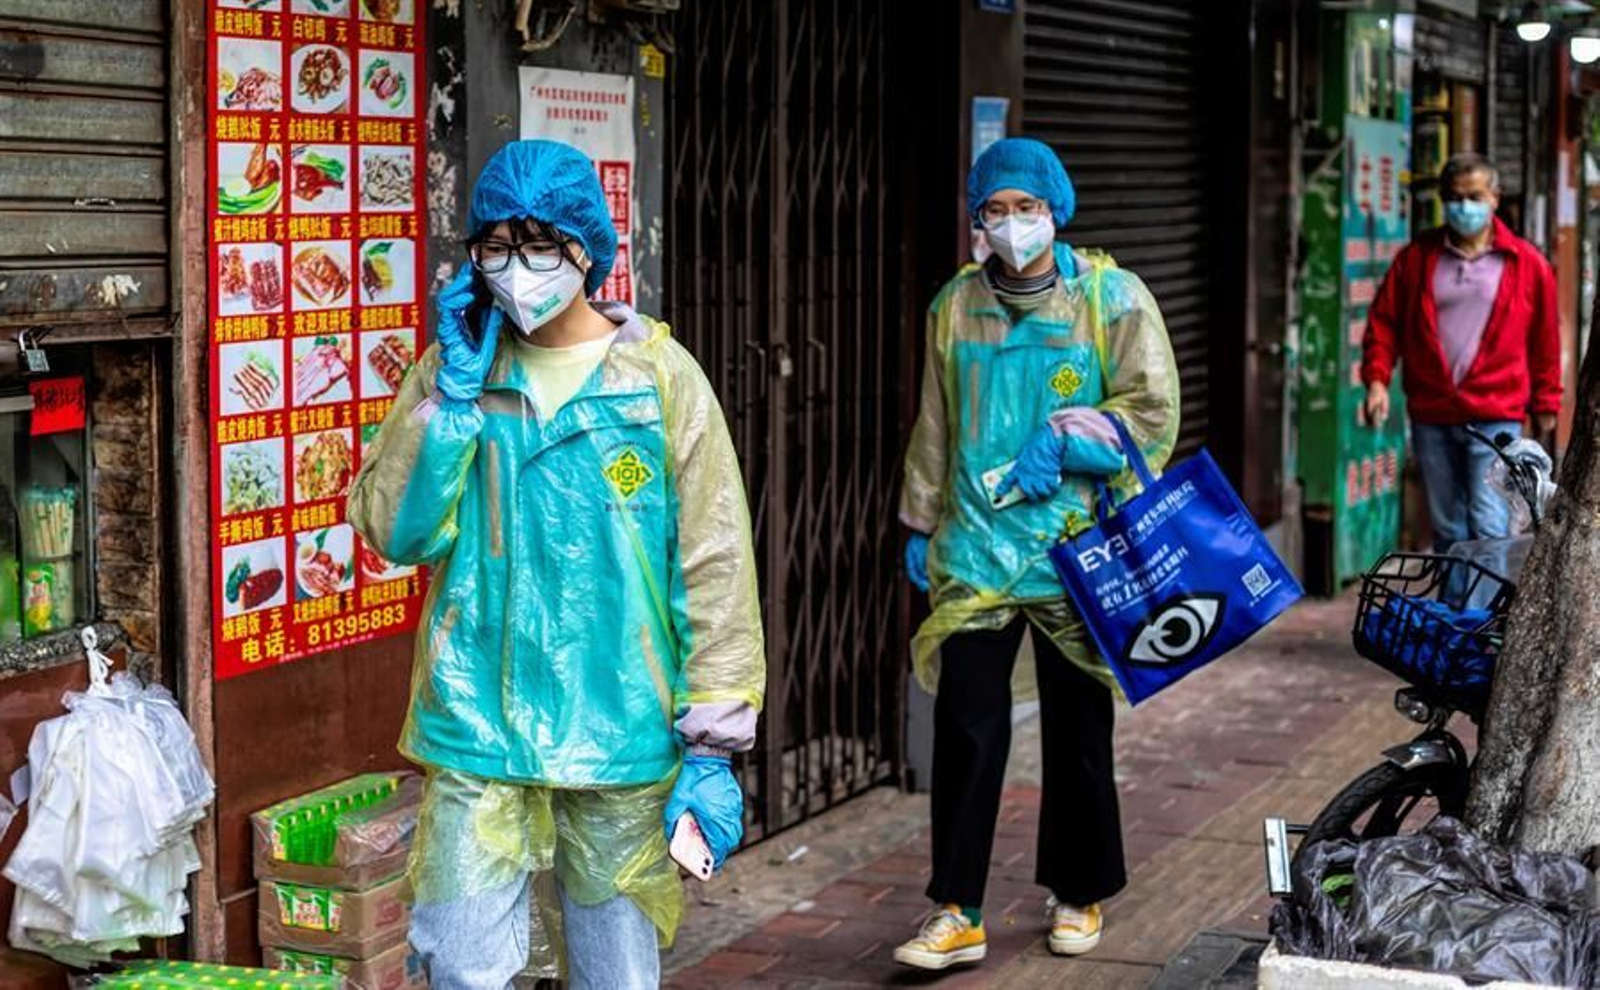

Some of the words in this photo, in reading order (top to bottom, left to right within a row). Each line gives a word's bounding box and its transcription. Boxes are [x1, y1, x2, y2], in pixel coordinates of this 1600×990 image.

[272, 15, 281, 37] 元
[336, 21, 347, 42] 元
[405, 28, 414, 48] 元
[269, 118, 281, 140] 元
[342, 120, 351, 141] 元
[408, 123, 417, 143] 元
[274, 217, 285, 240] 元
[341, 216, 352, 239] 元
[408, 214, 418, 237] 元
[276, 314, 287, 337] 元
[410, 304, 420, 326] 元
[273, 413, 283, 436] 元
[342, 405, 352, 426] 元
[272, 512, 284, 535] 元
[270, 608, 282, 630] 元
[307, 602, 406, 645] 81395883
